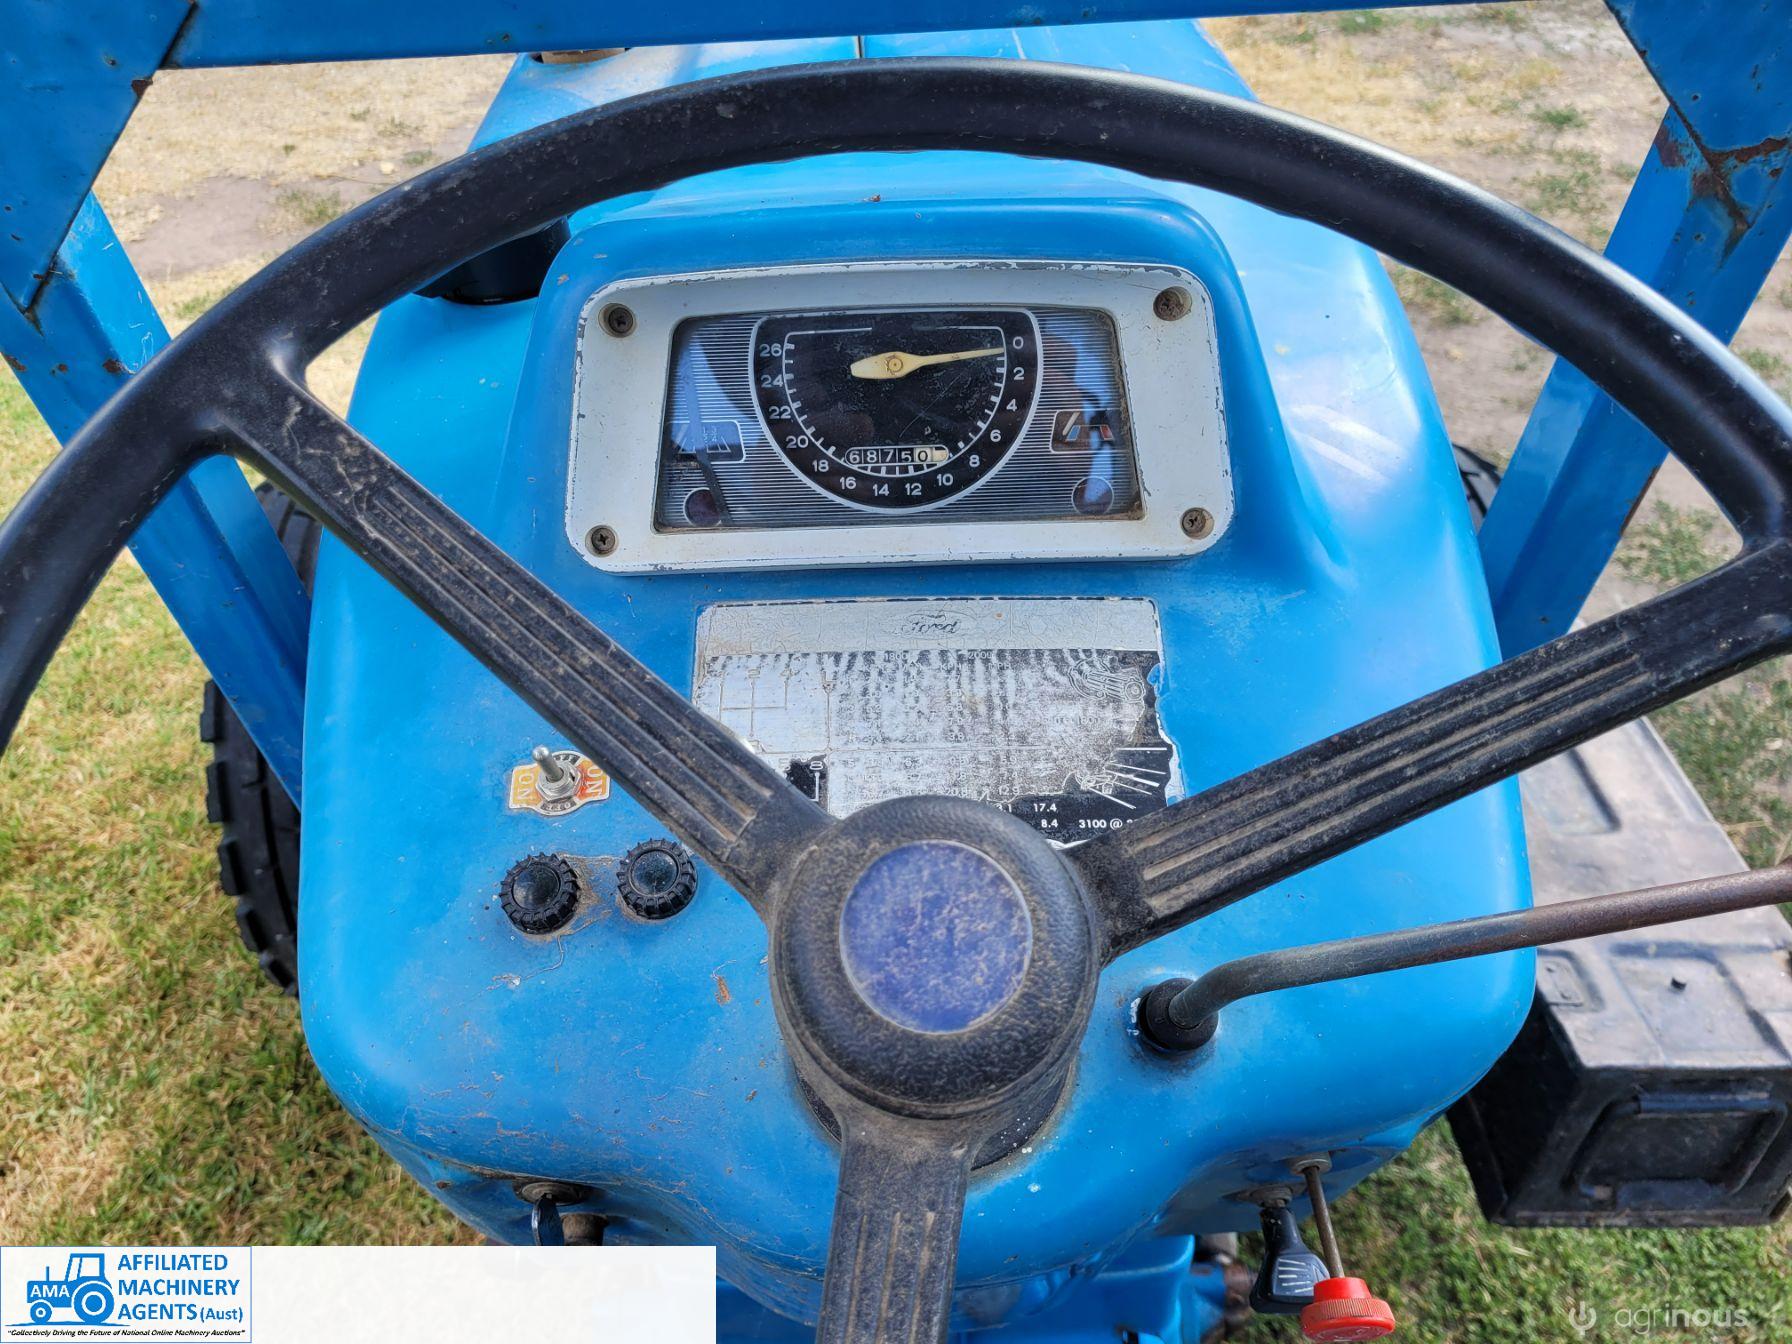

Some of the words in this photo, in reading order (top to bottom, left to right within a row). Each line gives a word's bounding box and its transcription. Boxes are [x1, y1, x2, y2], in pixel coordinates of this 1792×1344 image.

[1012, 336, 1024, 349] 0
[759, 343, 782, 357] 26
[1013, 367, 1025, 380] 2
[760, 374, 783, 387] 24
[1006, 399, 1018, 411] 4
[768, 405, 791, 419] 22
[786, 435, 809, 448] 20
[990, 429, 1002, 442] 6
[812, 459, 830, 472] 18
[969, 454, 981, 467] 8
[839, 476, 857, 489] 16
[936, 473, 954, 485] 10
[872, 483, 890, 496] 14
[905, 483, 922, 495] 12
[519, 773, 534, 799] ON
[587, 766, 603, 793] ON
[1033, 803, 1058, 812] 17.4
[1041, 819, 1058, 828] 8.4
[1079, 819, 1107, 828] 3100
[1110, 819, 1123, 830] @
